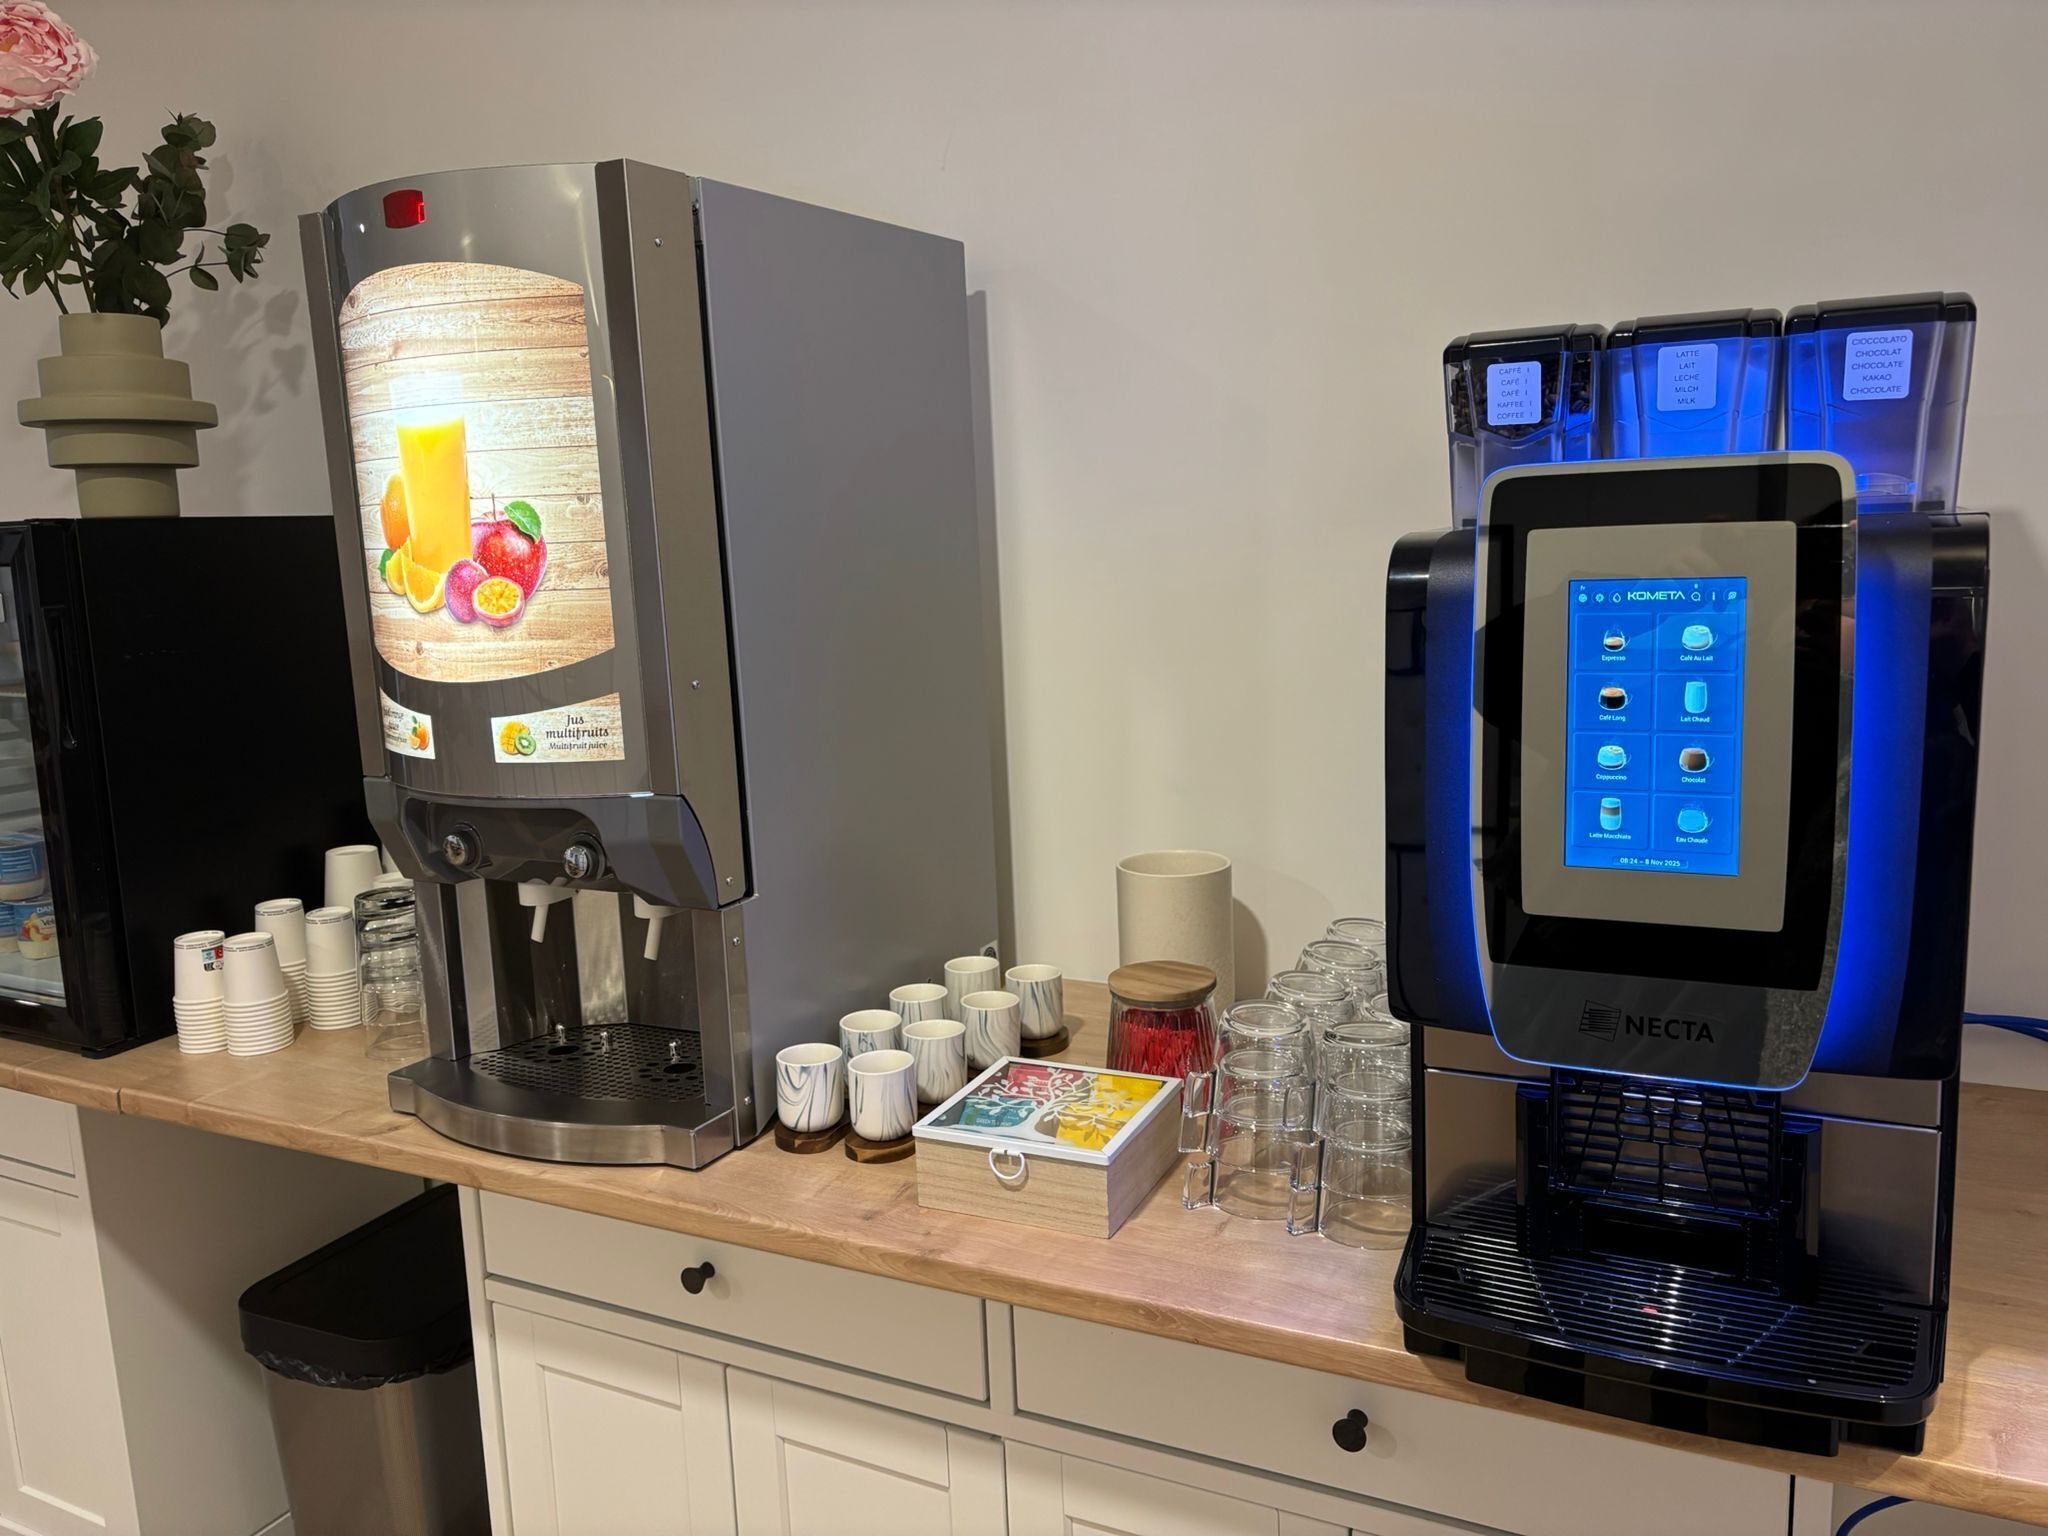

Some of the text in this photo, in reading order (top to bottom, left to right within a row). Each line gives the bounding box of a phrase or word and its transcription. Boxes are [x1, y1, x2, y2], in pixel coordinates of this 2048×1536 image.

[1852, 336, 1907, 345] CIOCCOLATO
[1676, 350, 1700, 358] LATTE
[1856, 348, 1902, 357] CHOCOLAT
[1852, 361, 1904, 370] CHOCOLATE
[1501, 389, 1520, 397] CAFÉ
[1850, 386, 1902, 394] CHOCOLATE
[1497, 412, 1524, 420] COFFEE
[1627, 591, 1685, 600] KOMETA
[565, 715, 584, 727] Jus
[546, 727, 609, 740] multifruits
[548, 742, 607, 750] Multifruit juice
[1626, 1014, 1714, 1043] NECTA
